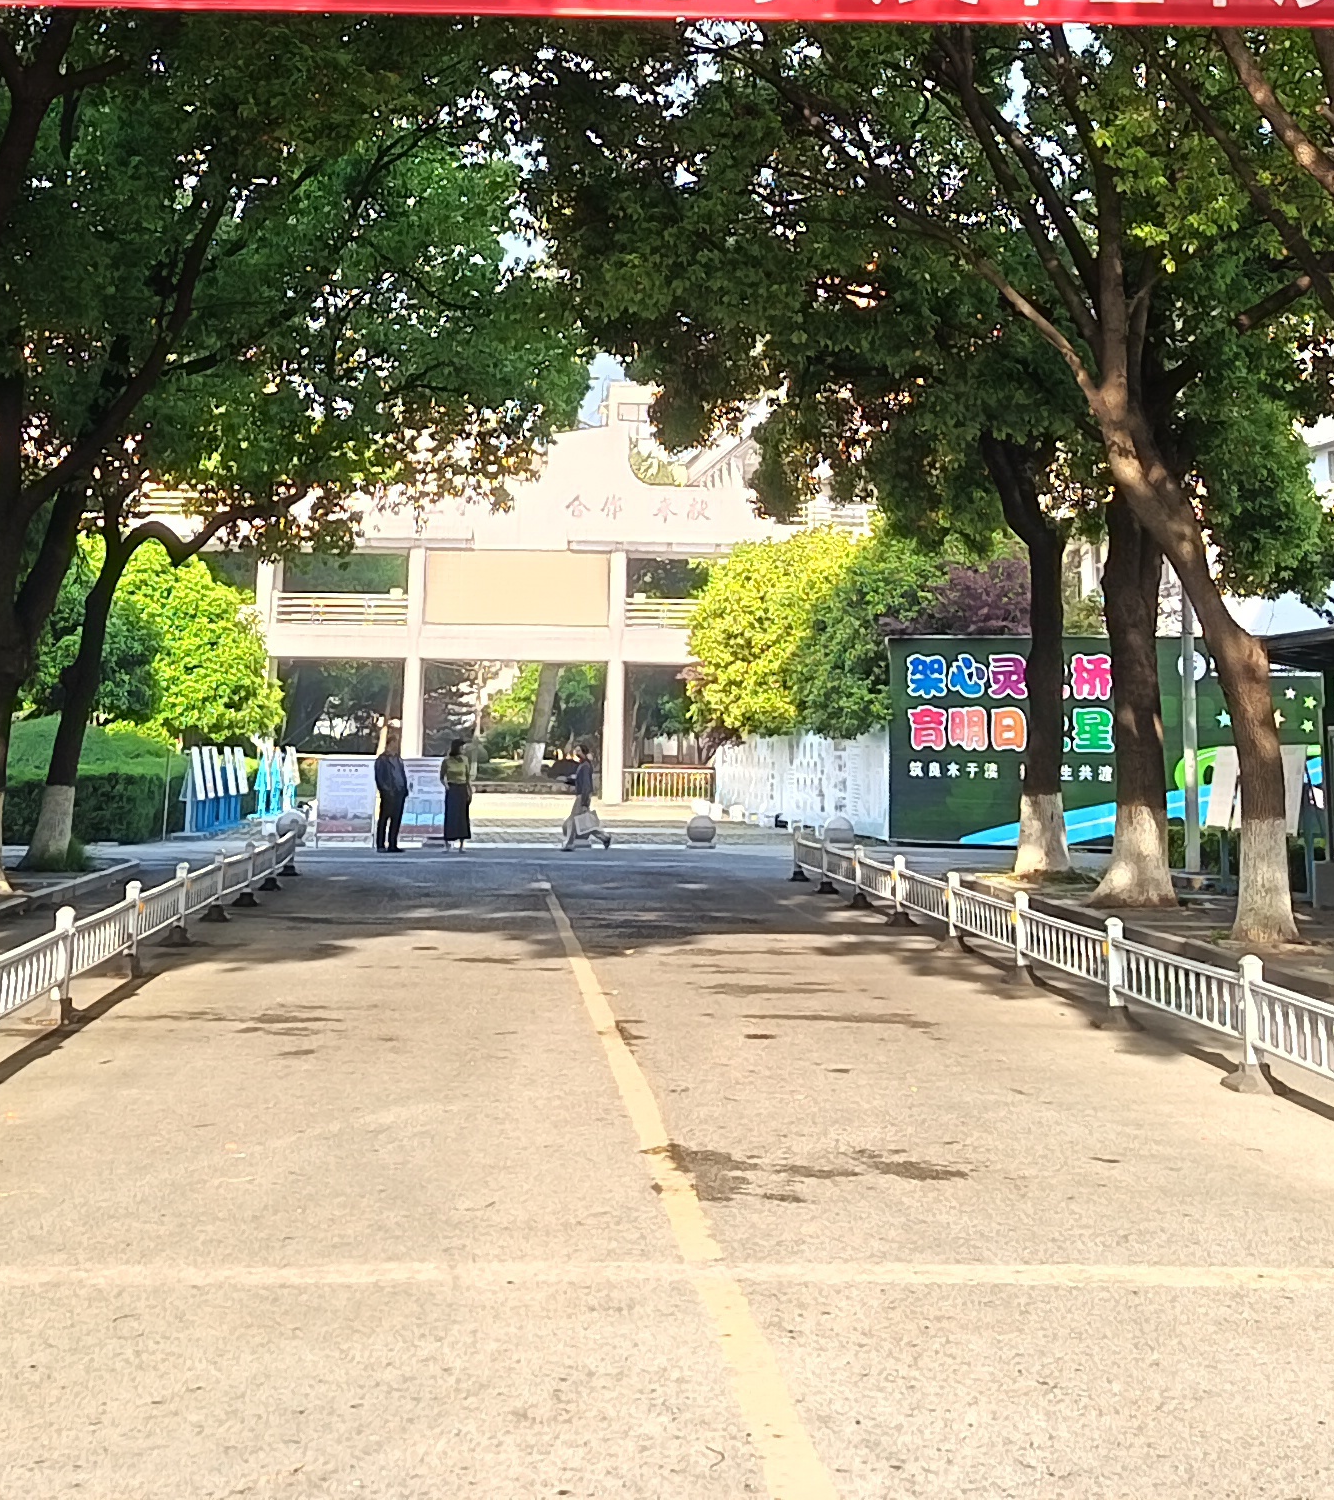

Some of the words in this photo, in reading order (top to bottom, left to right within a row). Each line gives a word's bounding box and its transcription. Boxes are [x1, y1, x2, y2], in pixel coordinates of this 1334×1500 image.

[907, 653, 1113, 700] 架心灵桥
[907, 705, 1116, 753] 育明日星
